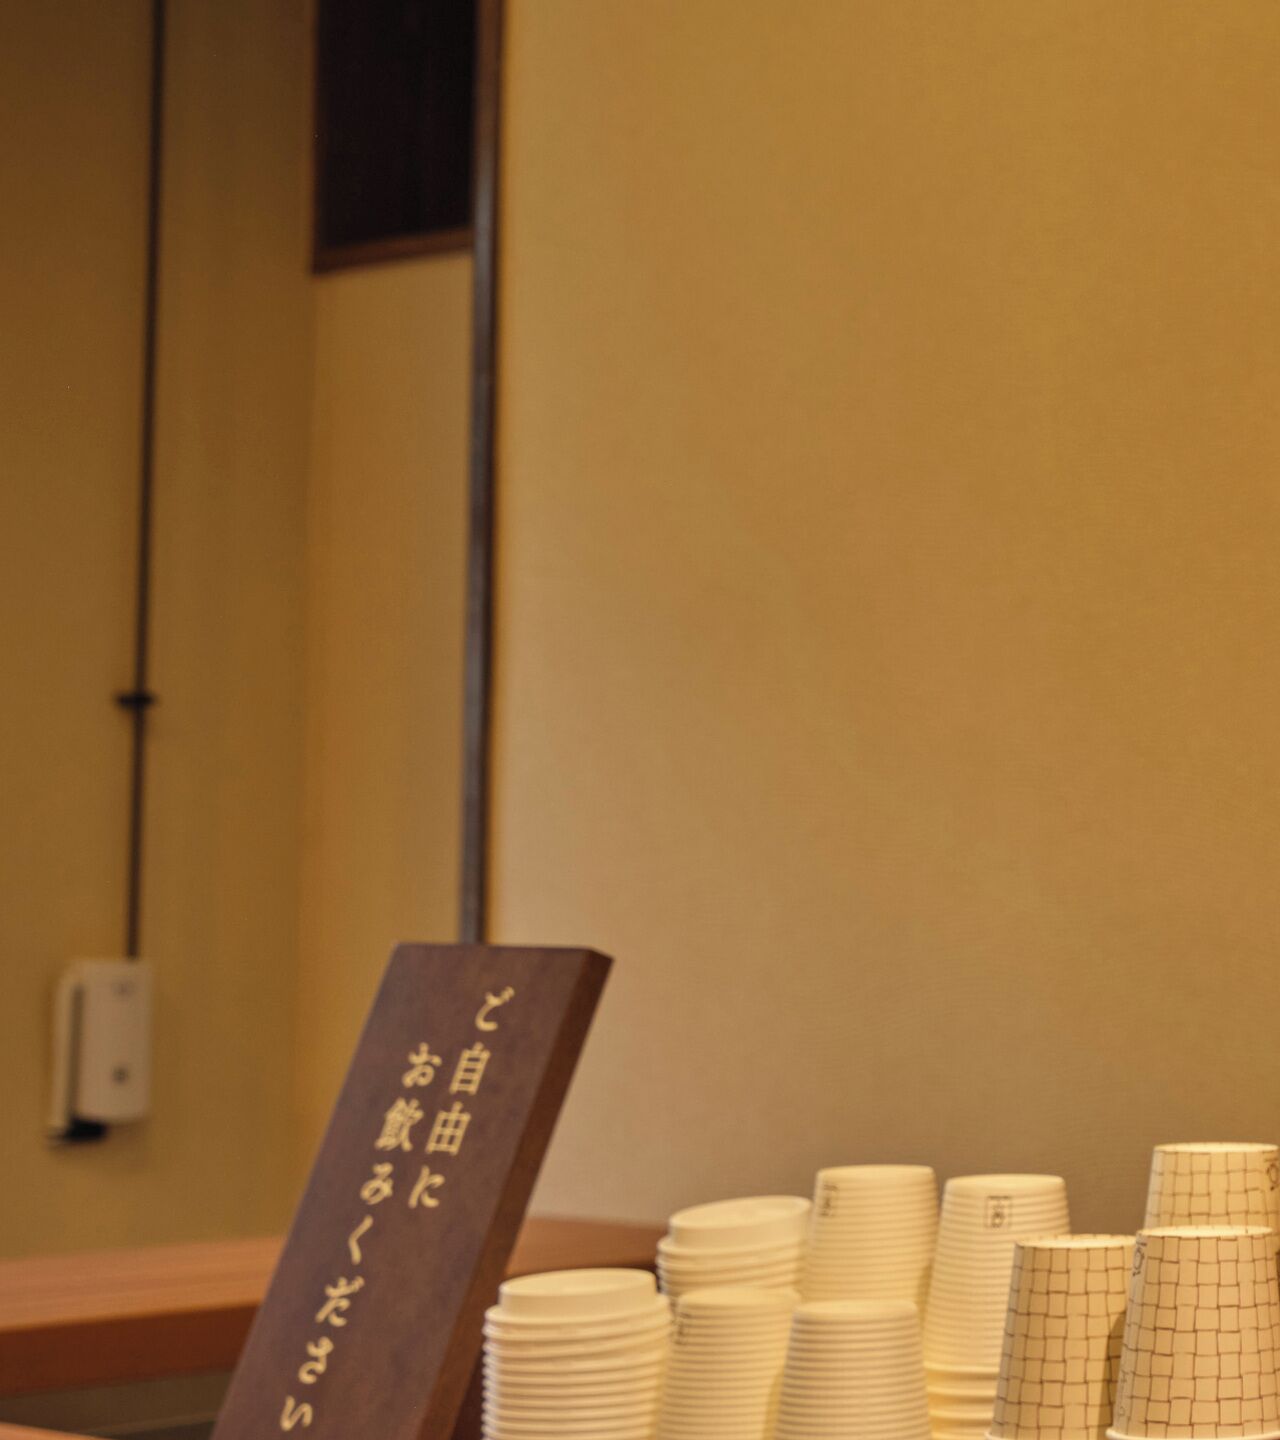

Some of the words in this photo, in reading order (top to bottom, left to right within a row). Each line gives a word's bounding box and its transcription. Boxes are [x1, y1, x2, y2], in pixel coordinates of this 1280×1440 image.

[280, 1042, 443, 1433] お飲みください
[407, 987, 516, 1211] ご自由に
